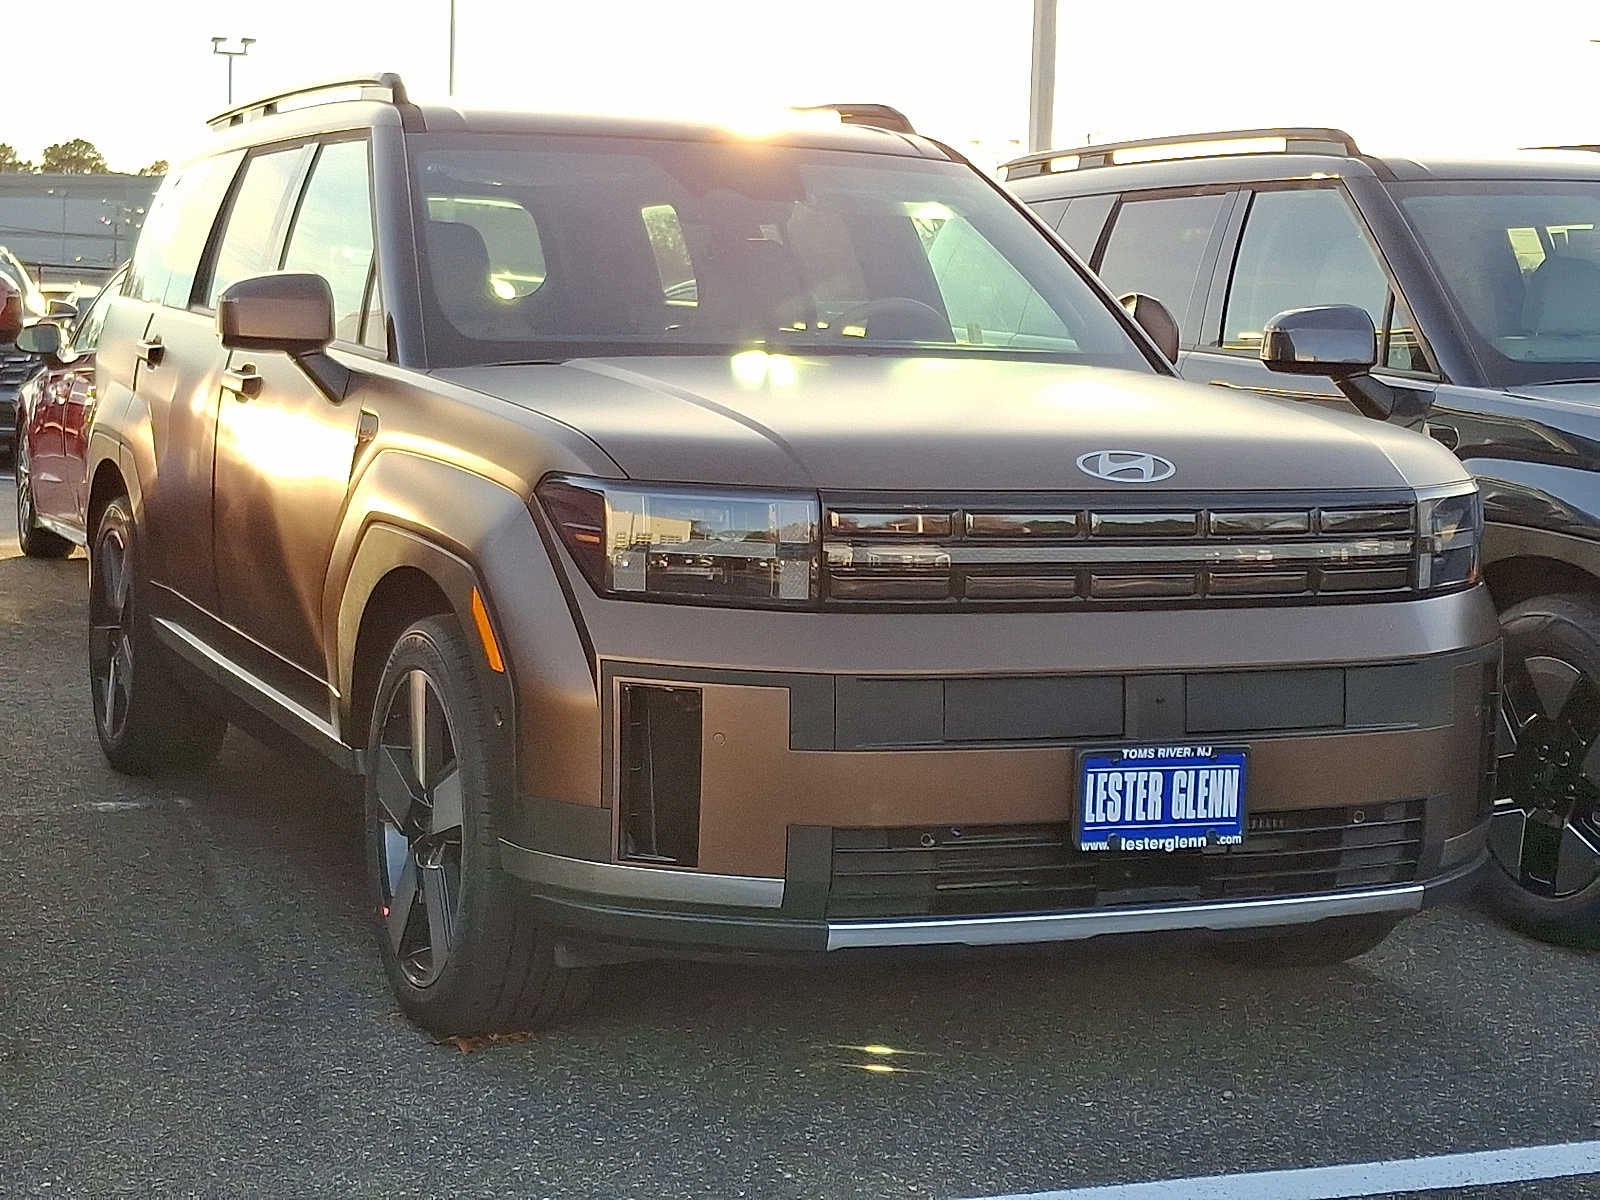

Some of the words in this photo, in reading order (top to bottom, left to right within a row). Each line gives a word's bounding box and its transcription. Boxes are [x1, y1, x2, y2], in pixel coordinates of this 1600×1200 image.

[1122, 748, 1155, 760] TOMS
[1196, 745, 1213, 758] NJ
[1085, 771, 1164, 823] LESTER
[1171, 769, 1240, 820] GLENN
[1120, 835, 1207, 852] lesterglenn
